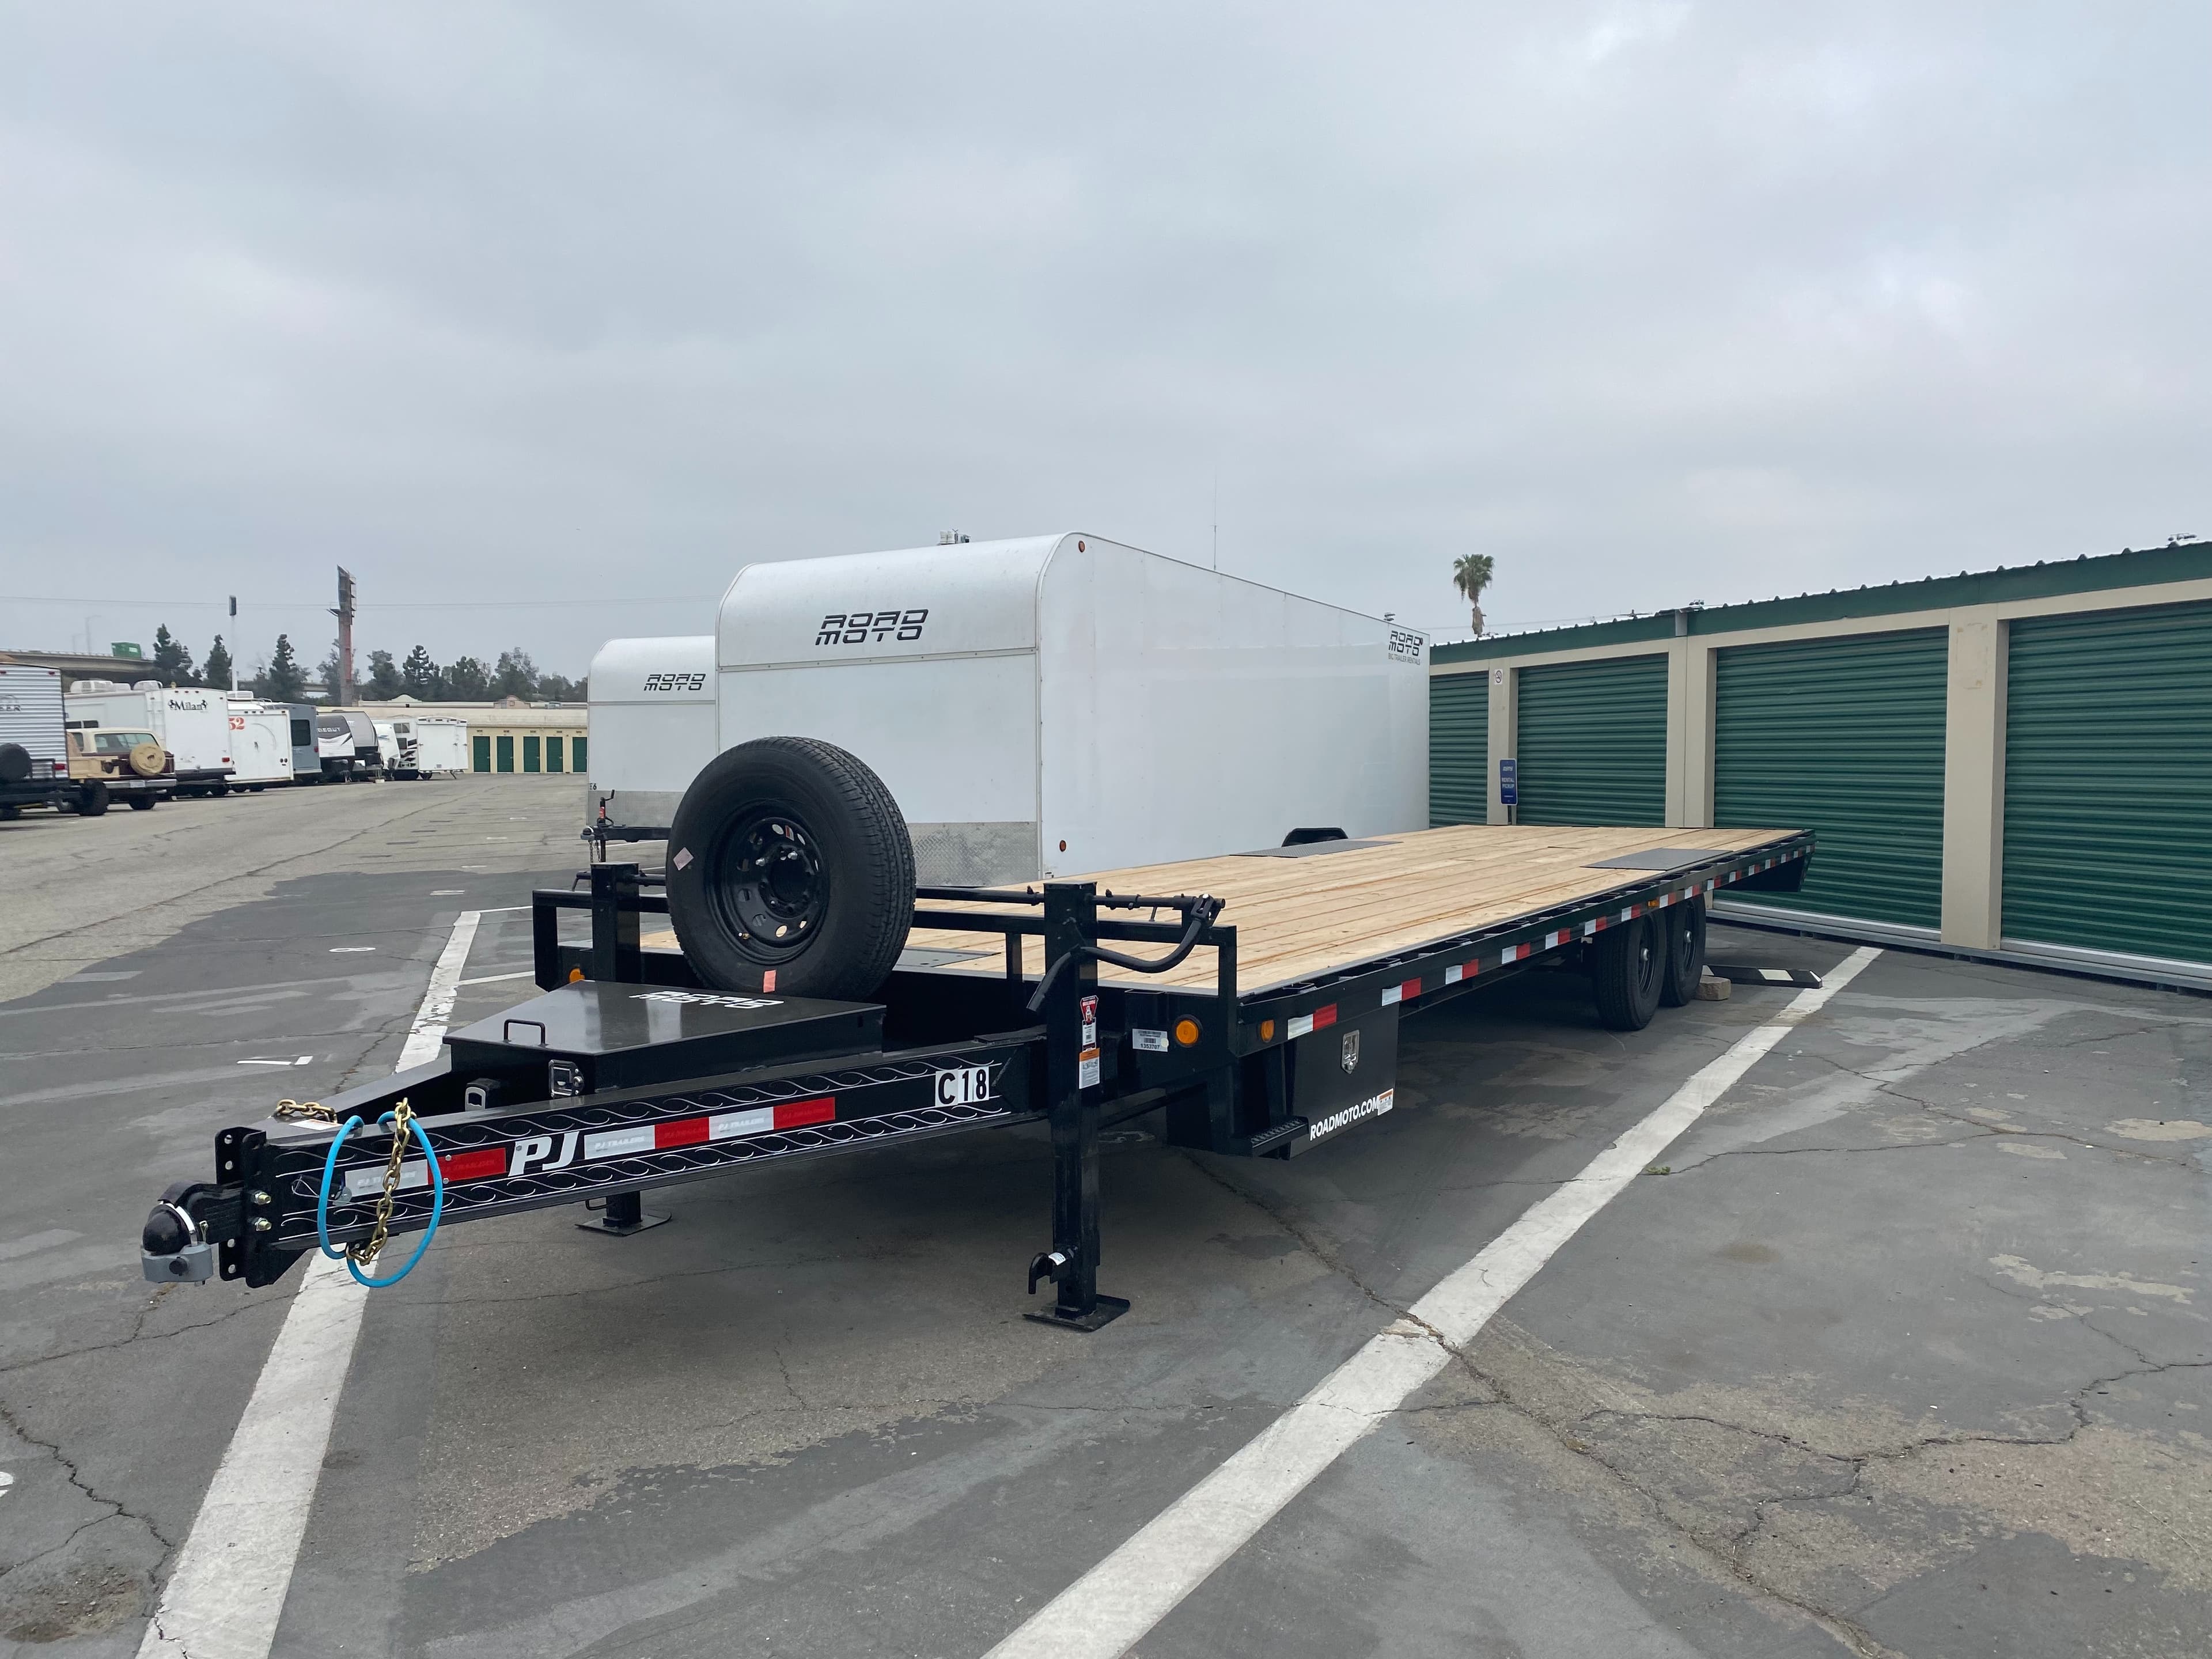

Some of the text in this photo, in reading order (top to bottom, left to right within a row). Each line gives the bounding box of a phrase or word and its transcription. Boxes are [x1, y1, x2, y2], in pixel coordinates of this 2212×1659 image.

[820, 609, 929, 629] ROAD
[815, 626, 922, 645] MOTO
[1391, 630, 1420, 646] ROAD
[1388, 641, 1419, 656] MOTO
[1394, 654, 1407, 662] TRAILER
[1407, 656, 1421, 665] RENTALS
[647, 673, 706, 682] ROAD
[643, 683, 703, 691] MOTO
[938, 1069, 987, 1105] C18
[1309, 1096, 1379, 1141] ROADMOTO.COM
[507, 1131, 579, 1177] PJ
